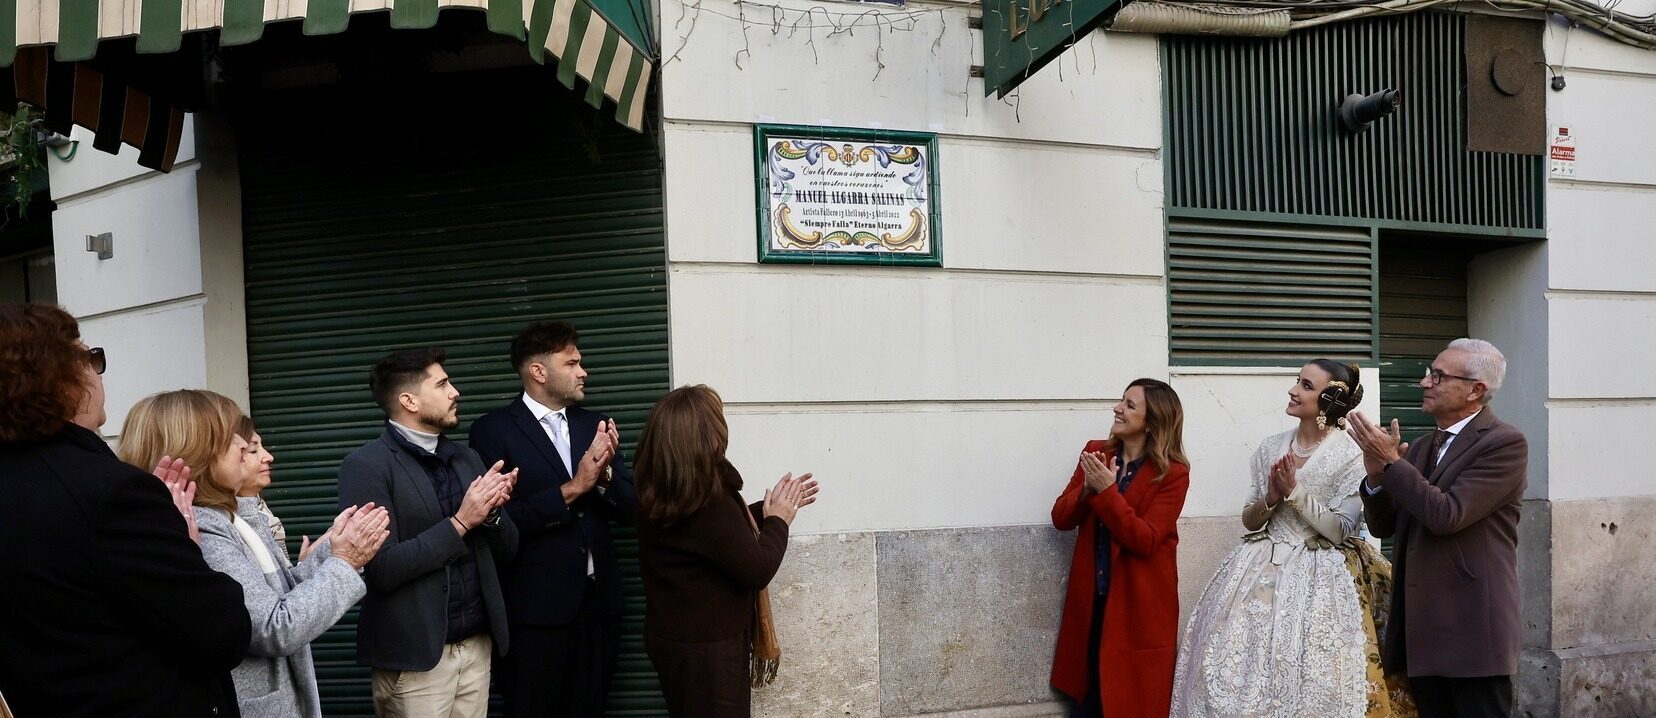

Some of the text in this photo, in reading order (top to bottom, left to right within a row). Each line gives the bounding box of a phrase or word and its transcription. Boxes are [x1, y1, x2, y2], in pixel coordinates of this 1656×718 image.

[1552, 147, 1576, 156] Alarma
[826, 168, 848, 176] llama
[795, 190, 905, 206] MANUEL ALGARRA SALINAS
[802, 208, 820, 216] Artista
[820, 208, 838, 216] Fallero
[844, 209, 858, 217] Abril
[875, 210, 888, 218] Abril
[854, 221, 876, 229] Eterno
[877, 221, 902, 230] Algarra
